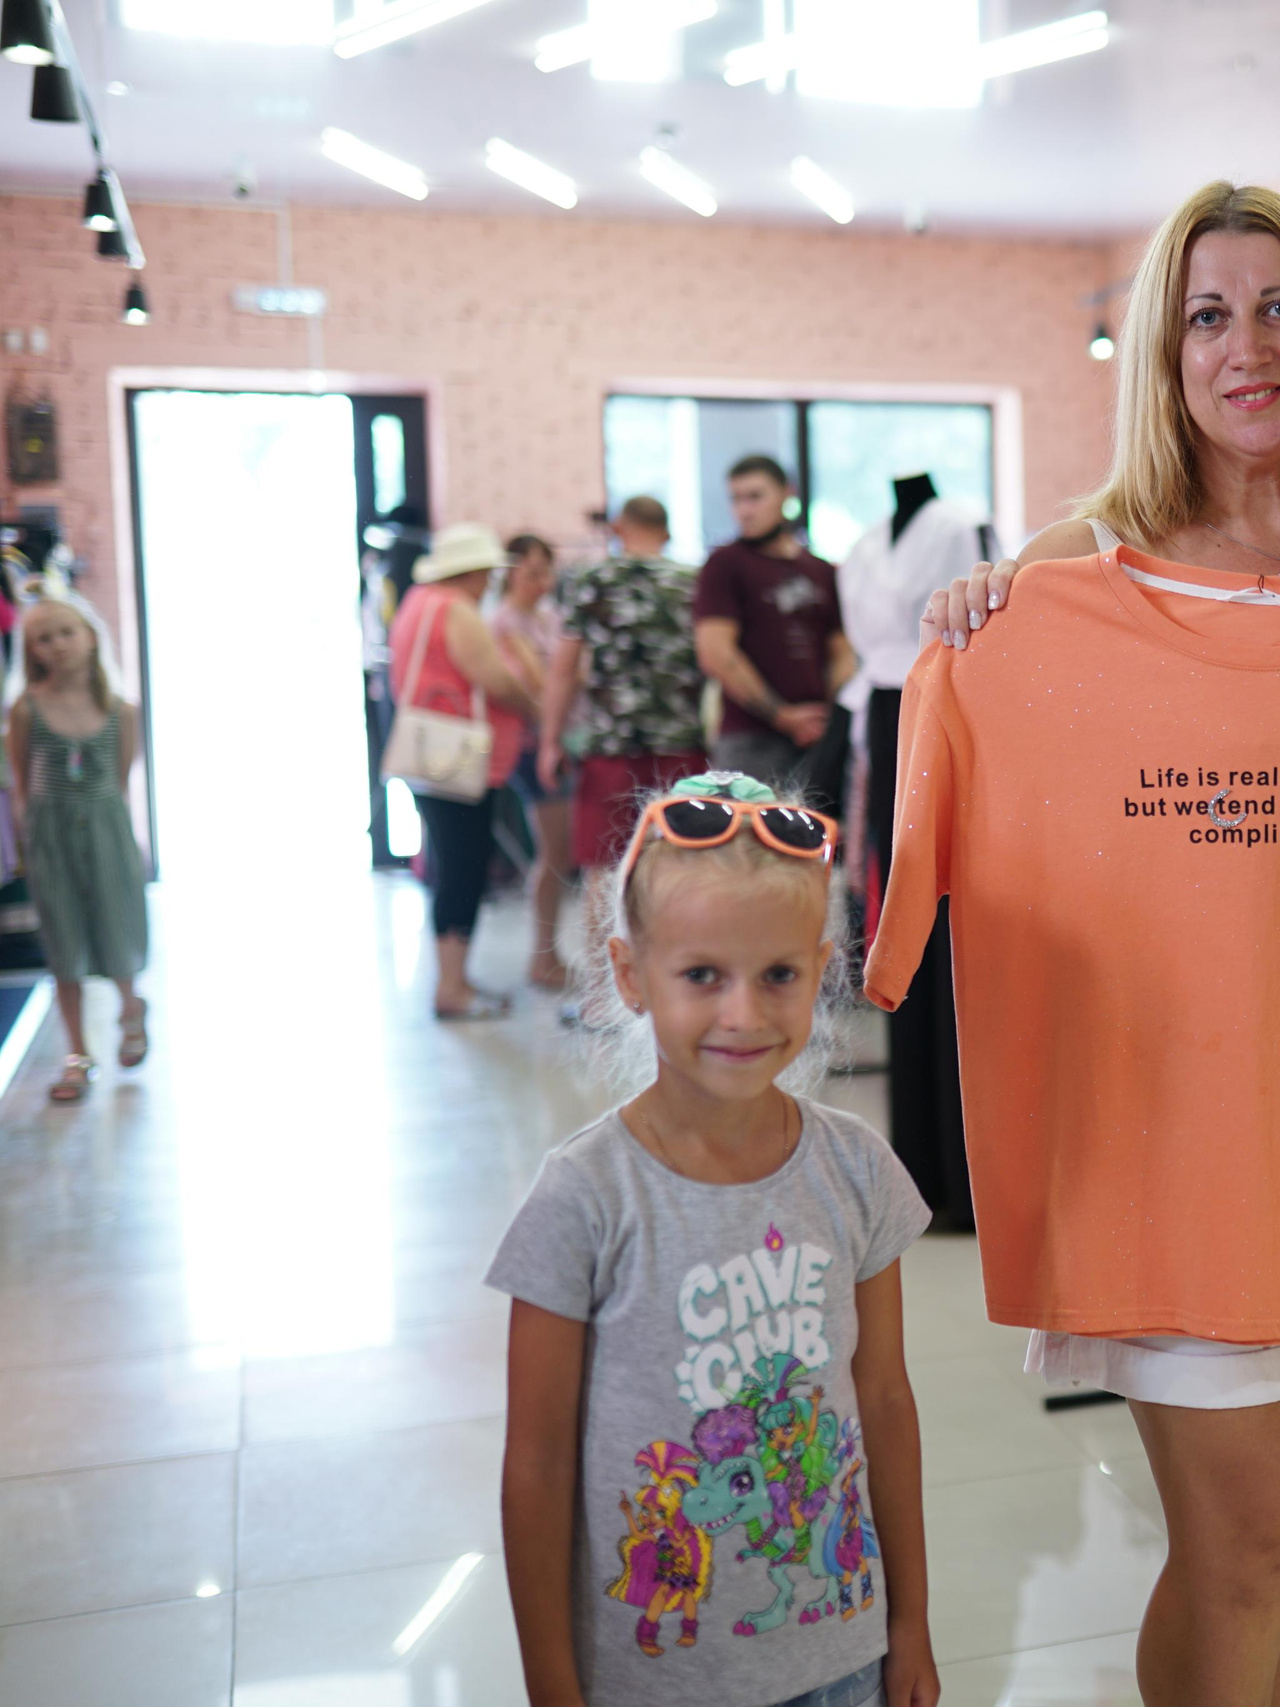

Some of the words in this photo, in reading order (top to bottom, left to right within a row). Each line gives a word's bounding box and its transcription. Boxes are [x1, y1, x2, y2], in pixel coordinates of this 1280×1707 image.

[1140, 767, 1189, 788] Life
[1198, 767, 1220, 786] is
[1124, 798, 1167, 817] but
[1174, 800, 1209, 815] we
[1216, 796, 1275, 815] tend
[678, 1242, 834, 1343] CAVE
